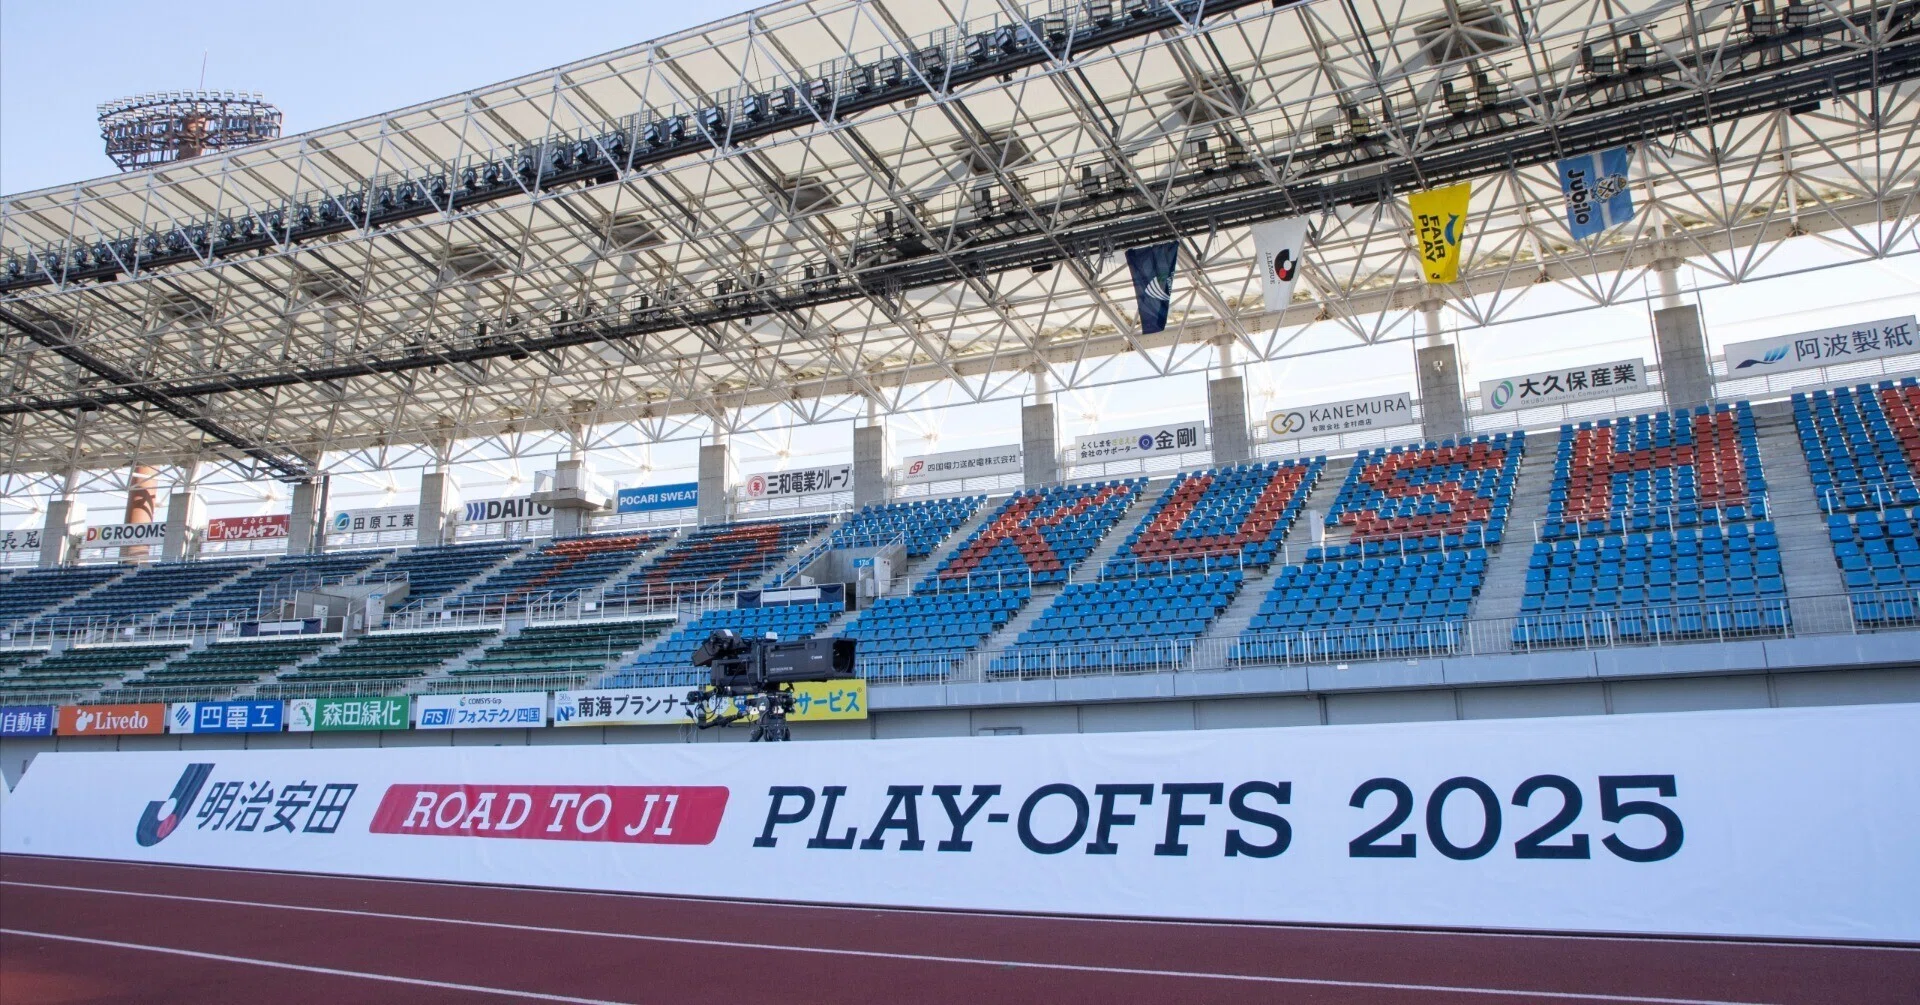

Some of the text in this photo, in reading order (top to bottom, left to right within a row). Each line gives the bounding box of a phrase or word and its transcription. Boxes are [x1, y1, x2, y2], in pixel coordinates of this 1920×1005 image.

[1418, 214, 1436, 263] PLAY
[1429, 215, 1446, 259] FAIR
[1794, 323, 1913, 361] 阿波製紙
[1519, 363, 1636, 398] 大久保産業
[1520, 384, 1638, 405] OKUBO Industry Company Limited
[1309, 398, 1407, 422] KANEMURA
[1154, 427, 1197, 450] 金剛
[1312, 422, 1340, 432] 有限会社
[927, 454, 1017, 472] 四国電力送配電株式会社
[1081, 446, 1138, 458] 会社のサポーター
[766, 466, 850, 494] 三和電業グループ
[486, 498, 550, 520] DAITO
[619, 490, 698, 506] POCARI SWEAT
[224, 524, 288, 538] ドリームギフト
[353, 513, 415, 530] 田原工業
[0, 530, 40, 550] 長尾
[200, 705, 275, 729] 四電工
[321, 700, 402, 726] 森田緑化
[458, 708, 540, 724] フォステクノ四国
[578, 694, 695, 717] 南海プランナー
[0, 711, 47, 733] 自動車
[94, 711, 149, 730] Livedo
[196, 780, 359, 834] 明治安田
[402, 791, 679, 836] ROAD TO J1
[753, 774, 1684, 862] PLAY-OFFS 2025
